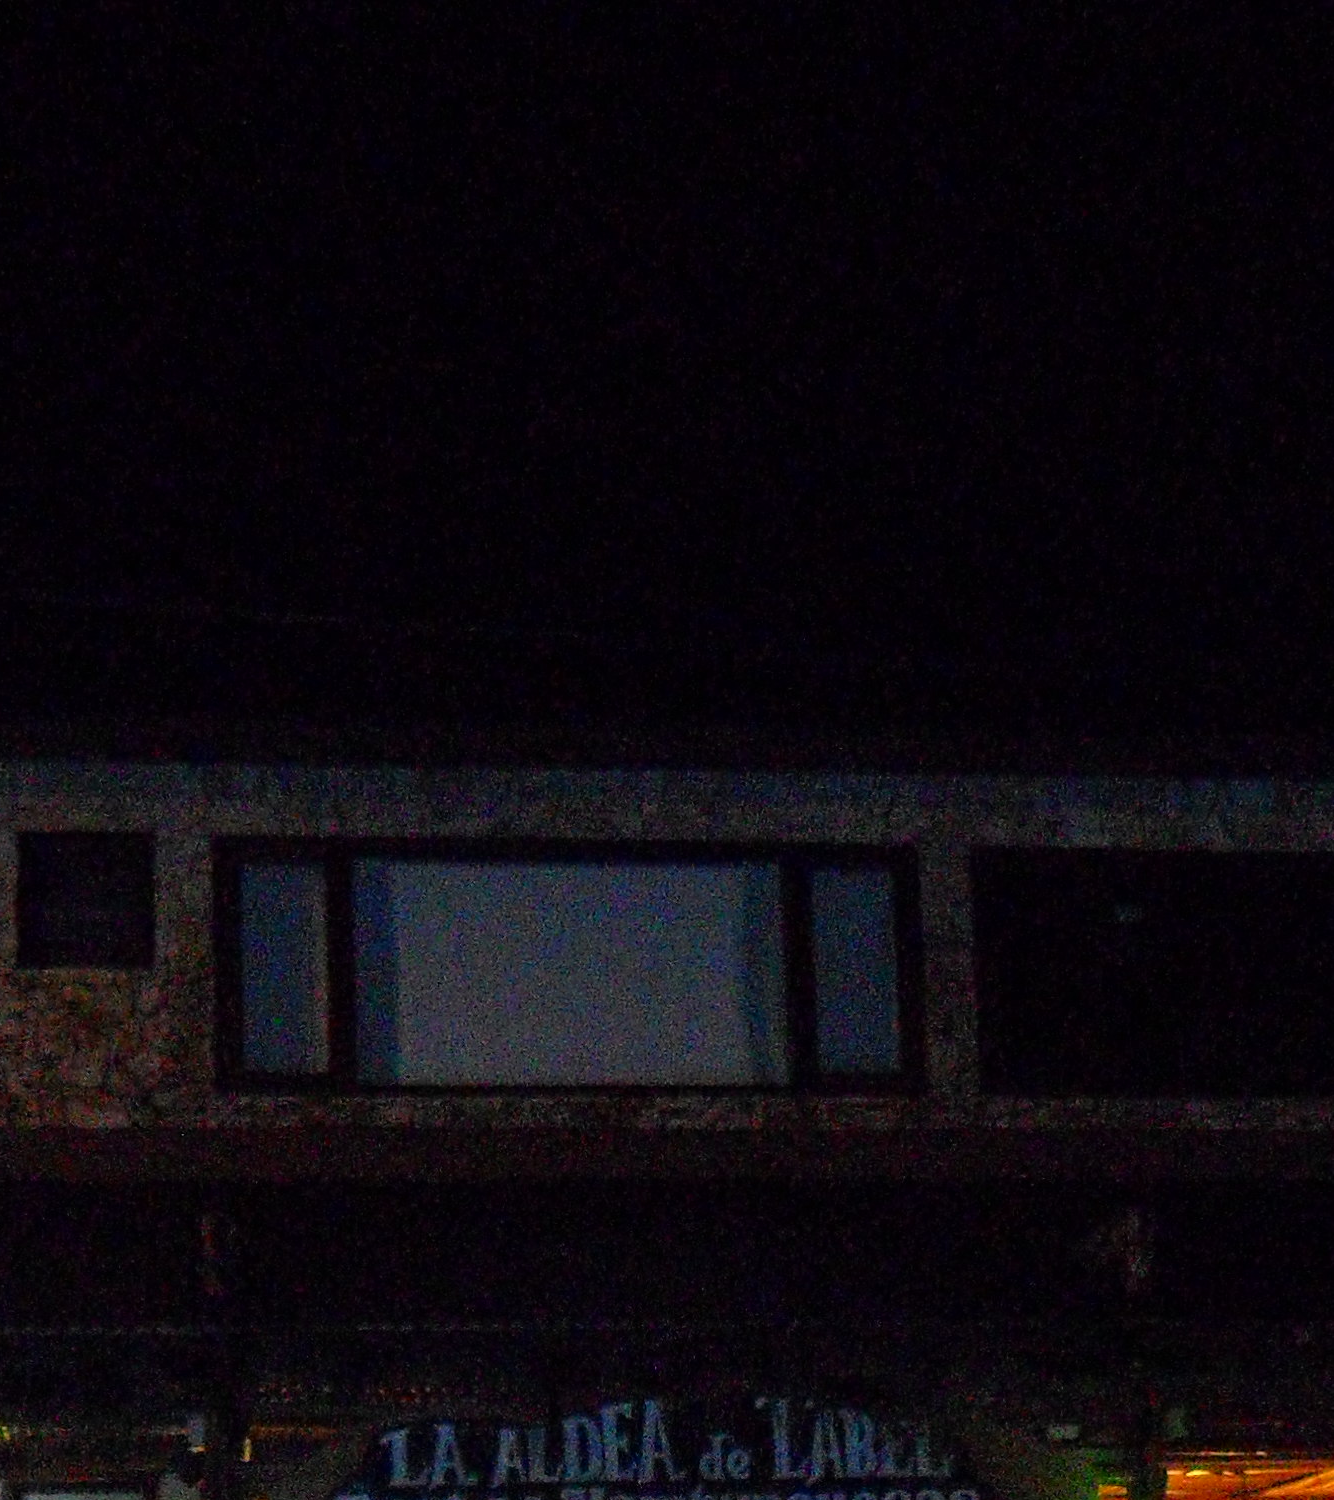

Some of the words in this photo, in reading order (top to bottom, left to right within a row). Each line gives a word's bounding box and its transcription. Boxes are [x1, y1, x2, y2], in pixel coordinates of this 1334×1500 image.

[378, 1420, 479, 1489] LA
[490, 1398, 686, 1489] ALDEA
[699, 1431, 751, 1483] de
